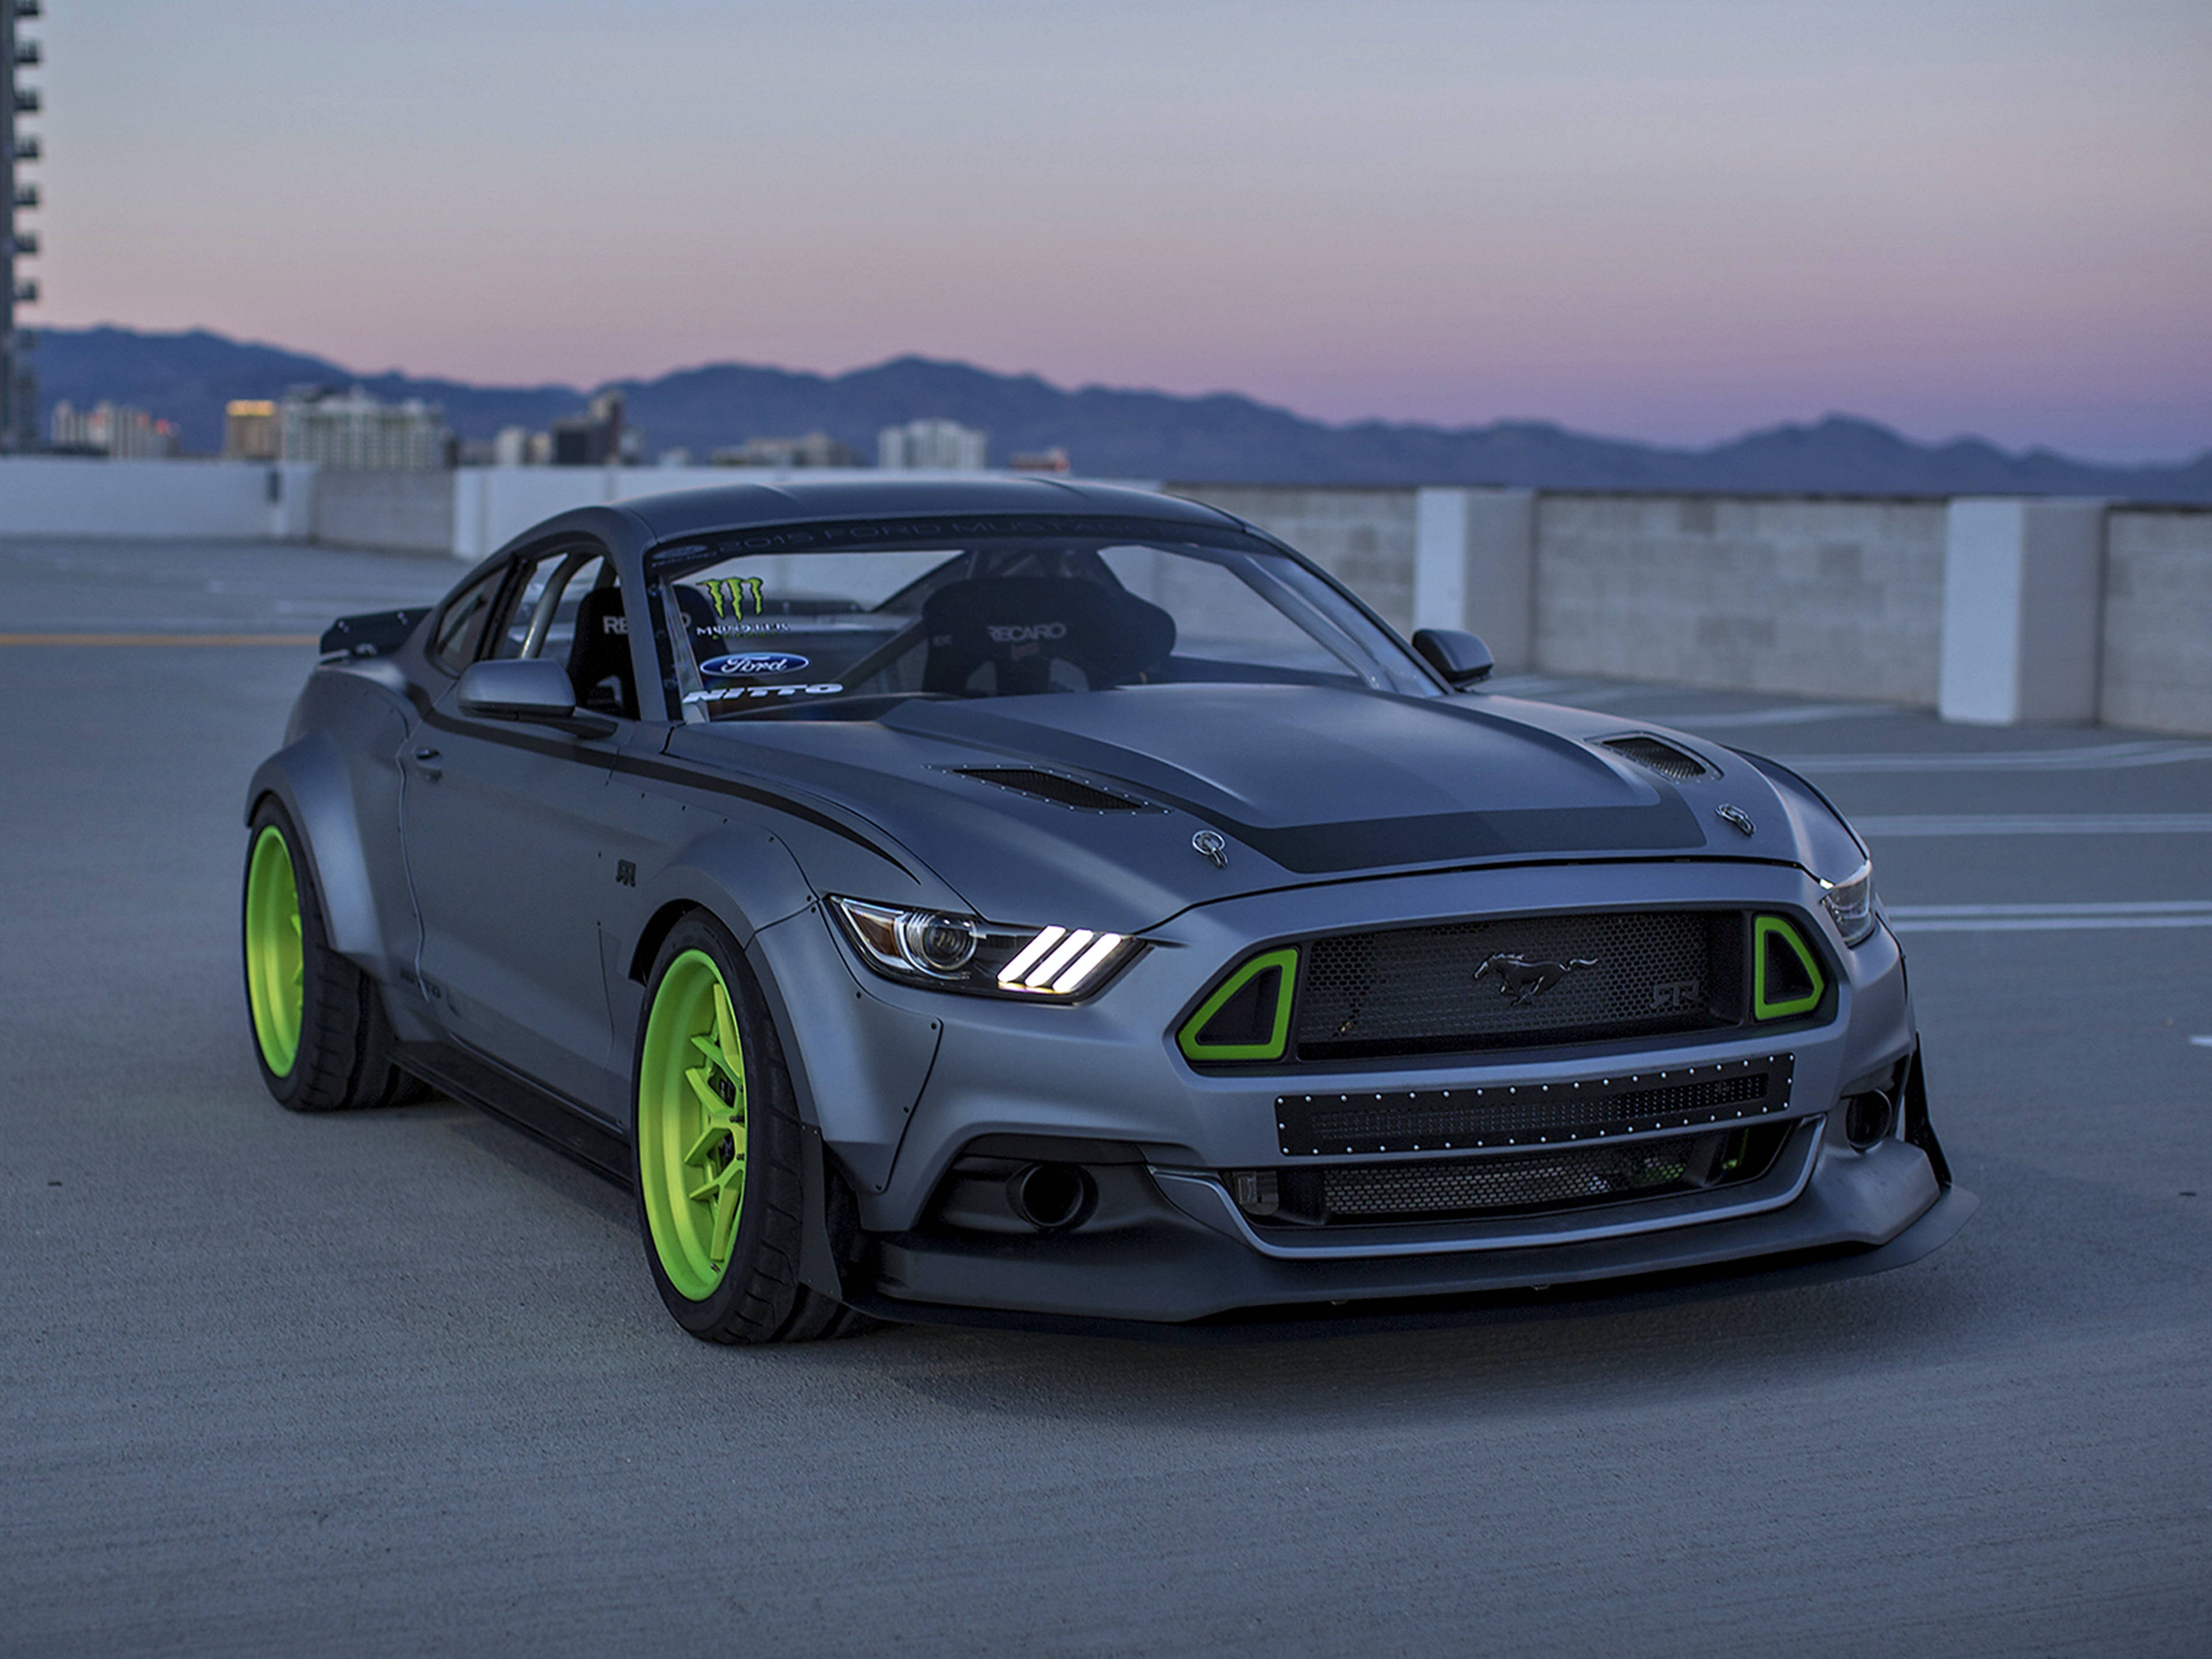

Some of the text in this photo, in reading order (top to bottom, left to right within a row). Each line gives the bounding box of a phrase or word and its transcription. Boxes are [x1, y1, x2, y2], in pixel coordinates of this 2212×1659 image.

[718, 531, 813, 553] 2015
[824, 524, 941, 540] FORD
[721, 656, 788, 673] Ford
[683, 683, 844, 703] NITTO
